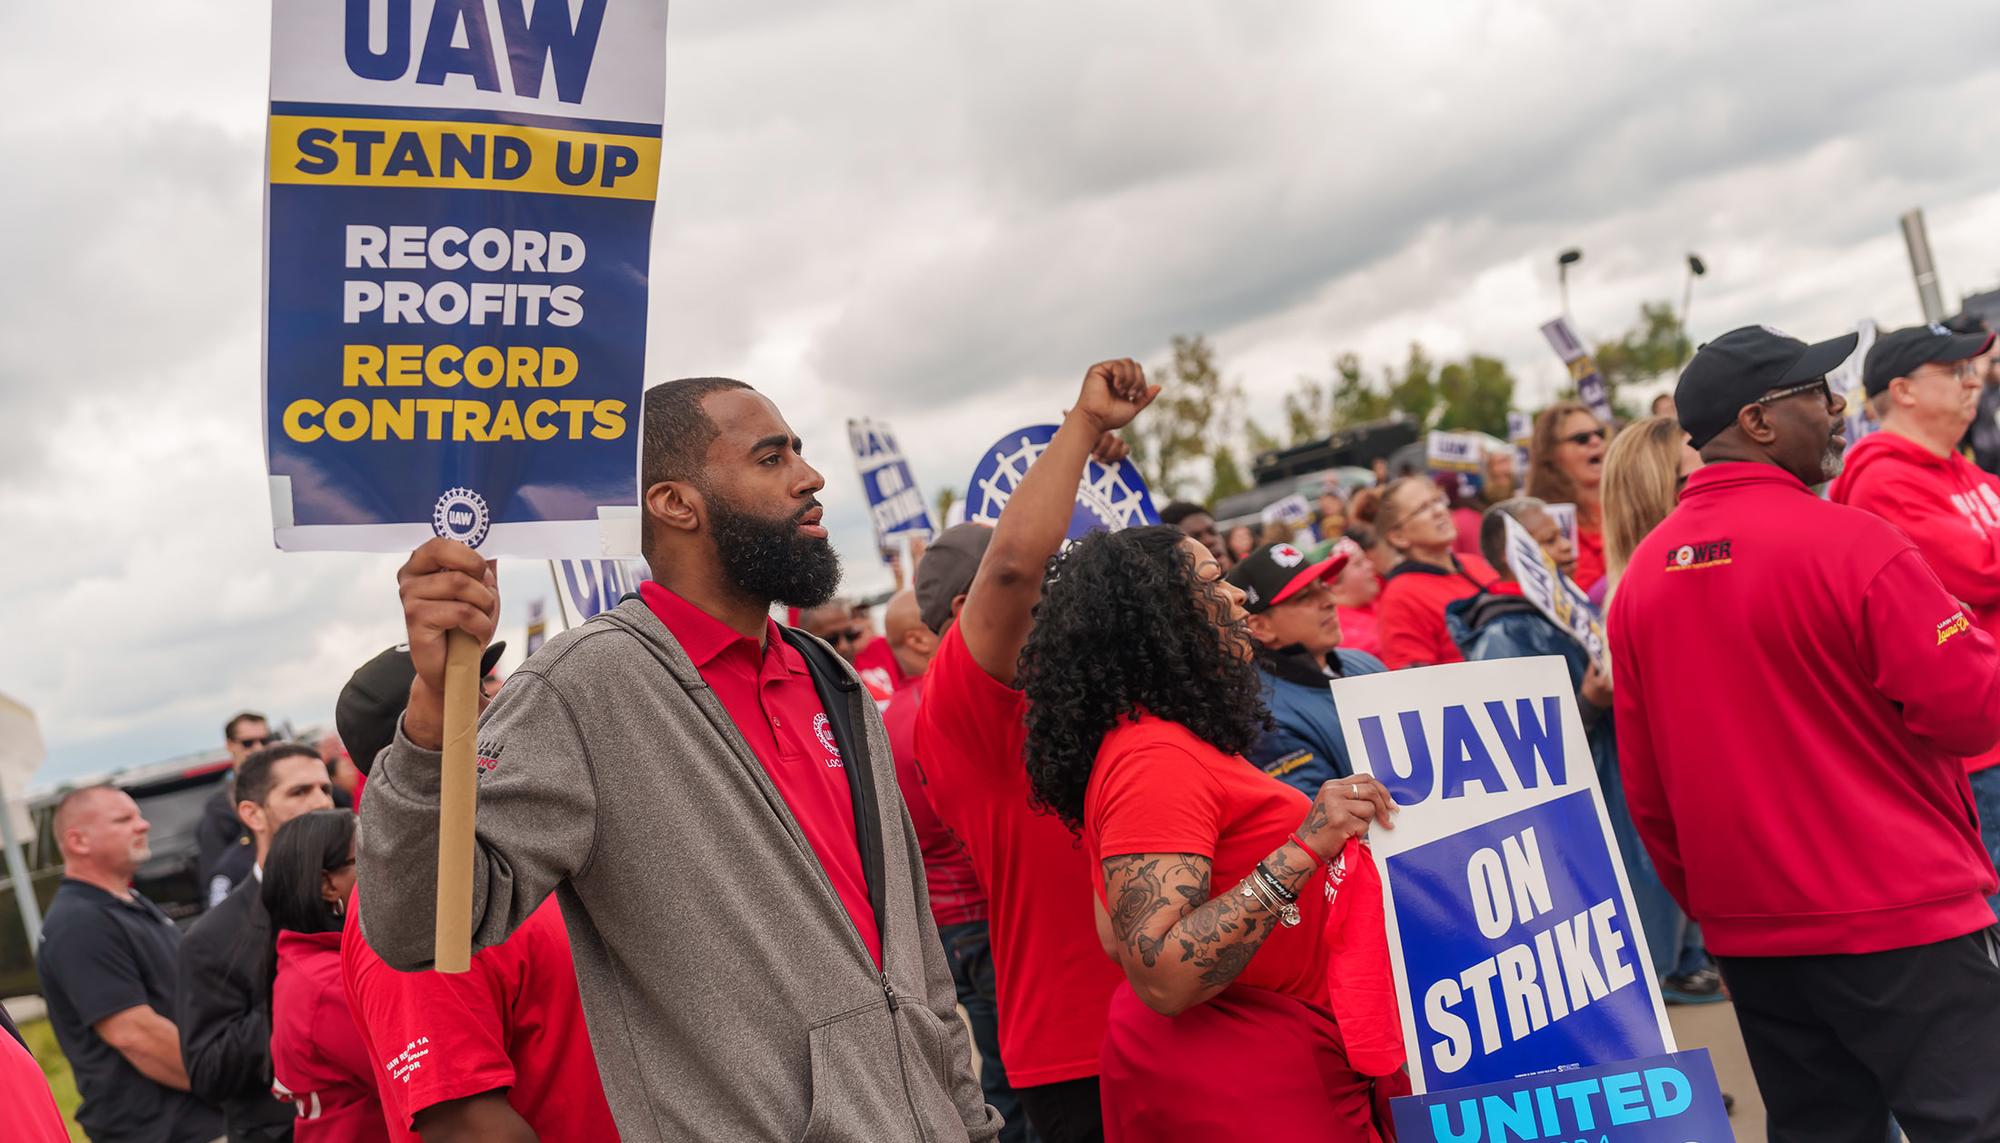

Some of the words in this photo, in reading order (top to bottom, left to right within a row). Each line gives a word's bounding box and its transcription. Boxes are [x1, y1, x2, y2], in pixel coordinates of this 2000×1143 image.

[345, 0, 606, 105] UAW
[294, 127, 533, 181] STAND
[554, 140, 640, 189] UP
[345, 224, 587, 273] RECORD
[343, 279, 585, 328] PROFITS
[342, 343, 580, 388] RECORD
[281, 398, 628, 443] CONTRACTS
[448, 510, 473, 526] UAW
[1666, 541, 1731, 567] POWER
[1357, 695, 1568, 807] UAW
[1466, 826, 1554, 940] ON
[1423, 897, 1637, 1074] STRIKE
[1429, 1066, 1693, 1143] UNITED
